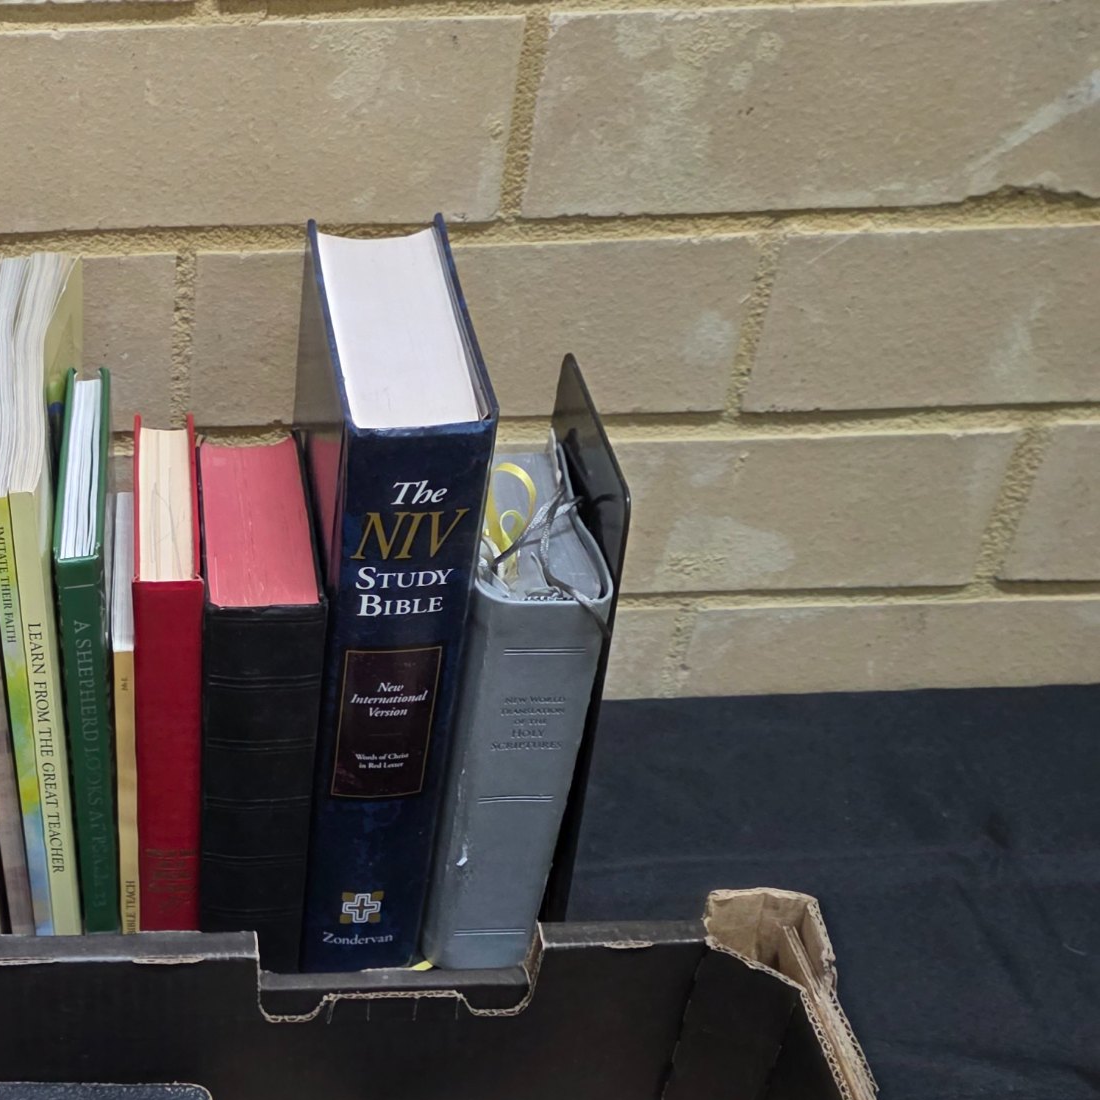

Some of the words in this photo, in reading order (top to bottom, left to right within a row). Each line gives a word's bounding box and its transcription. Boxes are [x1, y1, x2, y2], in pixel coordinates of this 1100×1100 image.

[390, 480, 448, 505] The
[350, 508, 470, 560] NIV
[355, 566, 455, 590] STUDY
[0, 575, 13, 611] THEIR
[356, 594, 444, 617] BIBLE
[4, 611, 17, 643] FAITH
[73, 620, 91, 634] A
[27, 623, 46, 674] LEARN
[75, 639, 99, 741] SHEPHERD
[350, 689, 428, 704] International
[377, 682, 404, 693] New
[33, 680, 51, 723] FROM
[369, 706, 408, 717] Version
[500, 707, 565, 717] TRANSLATION
[503, 696, 526, 706] NEW
[529, 695, 566, 705] WORLD
[510, 729, 545, 739] HOLY
[513, 718, 525, 727] OF
[529, 718, 547, 726] THE
[38, 727, 54, 757] THE
[490, 740, 562, 752] SCRIPTURES
[387, 752, 409, 760] Christ
[42, 762, 59, 810] GREAT
[84, 747, 102, 806] LOOKS
[47, 811, 65, 873] TEACHER
[125, 880, 135, 909] TEACH
[322, 931, 394, 946] Zondervan
